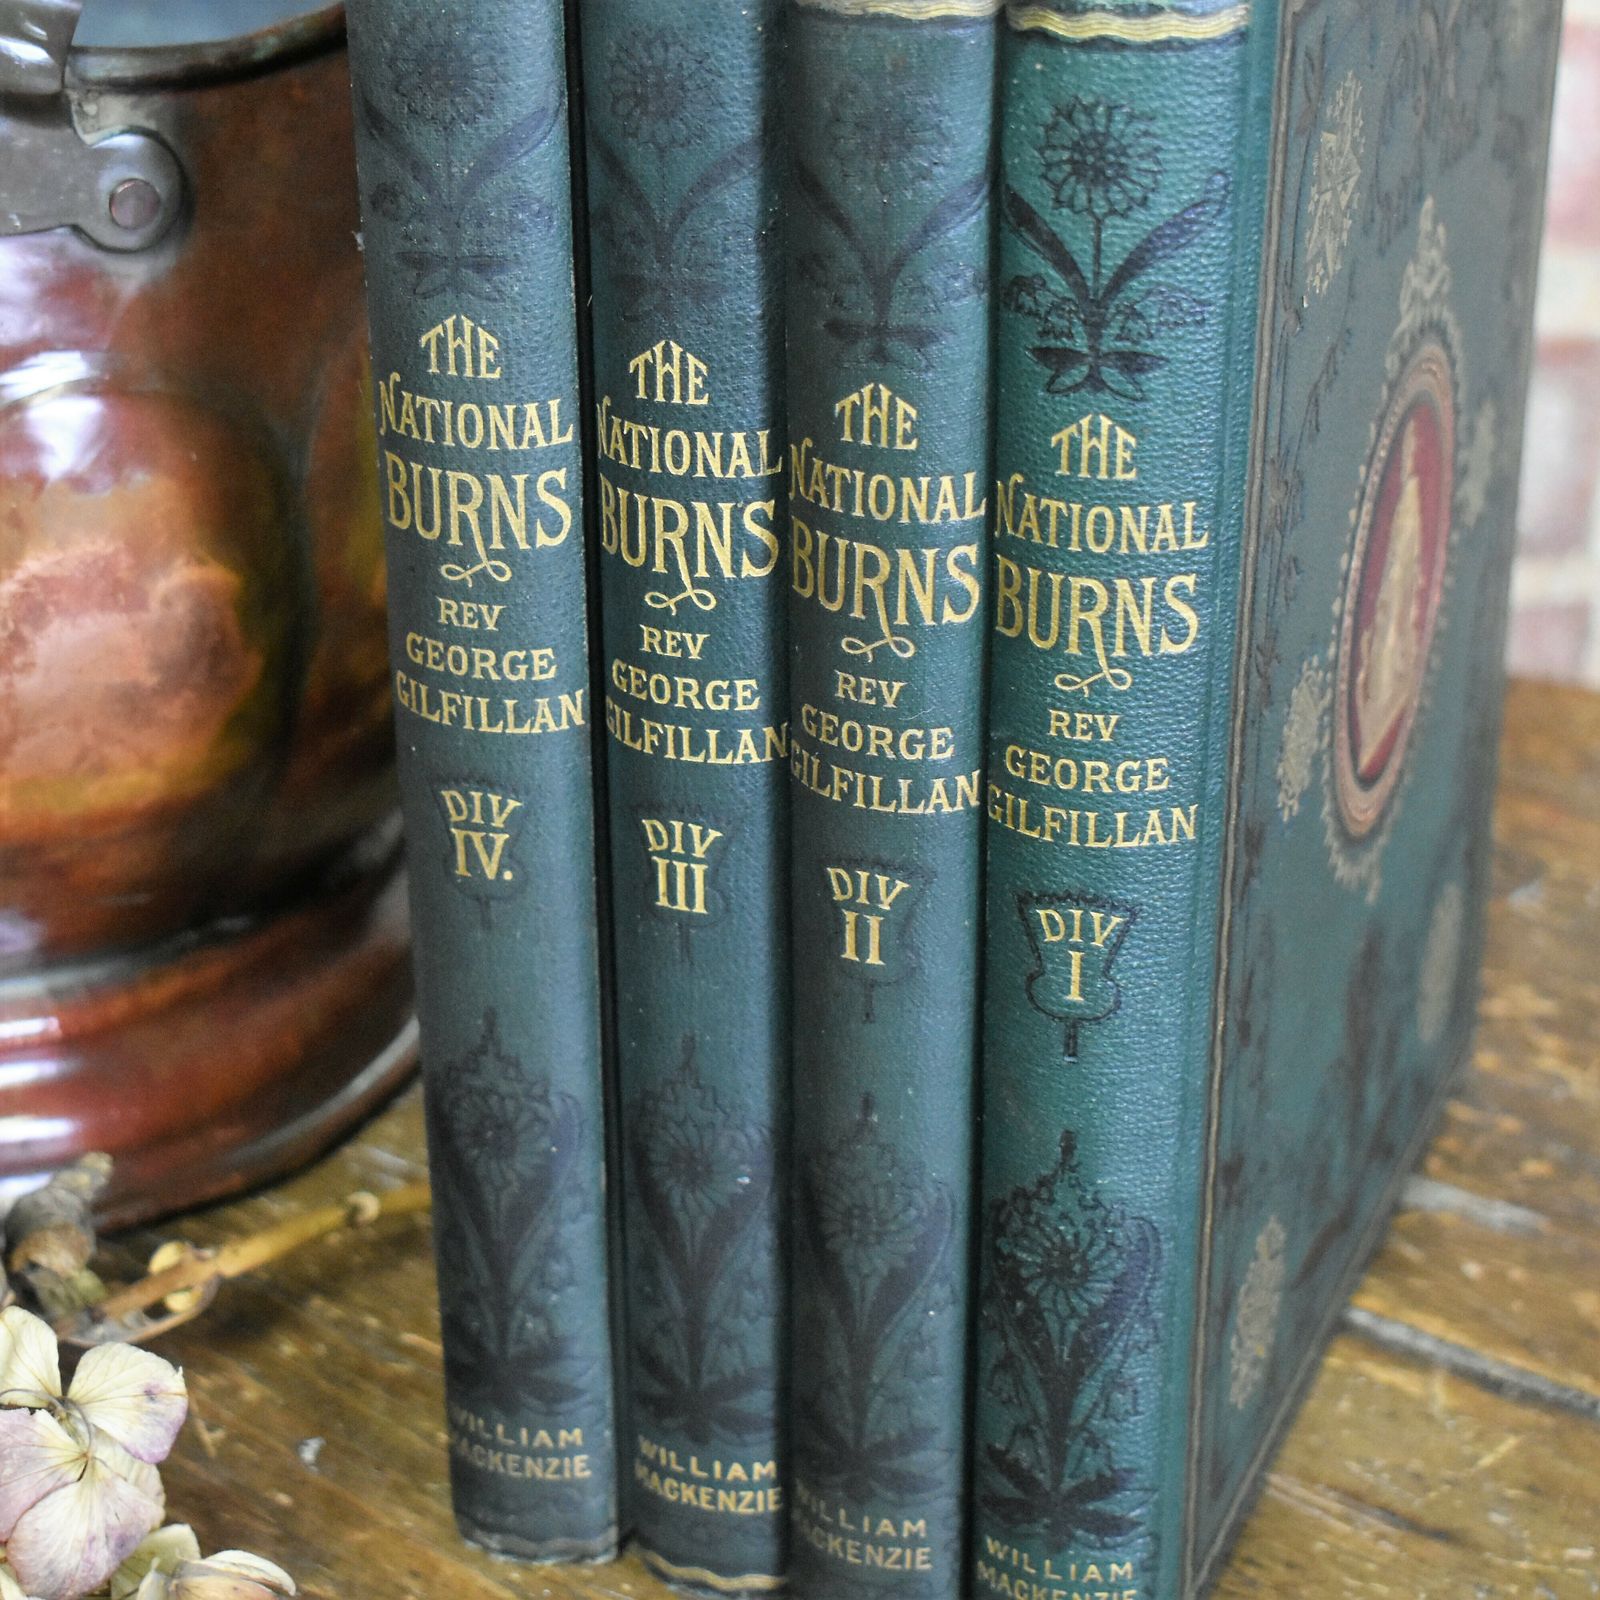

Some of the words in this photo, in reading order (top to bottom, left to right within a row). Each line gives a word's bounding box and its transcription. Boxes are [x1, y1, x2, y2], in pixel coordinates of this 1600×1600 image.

[421, 313, 502, 379] THE
[629, 339, 710, 405] THE
[378, 372, 574, 451] NATIONAL
[596, 395, 783, 479] NATIONAL
[835, 382, 918, 451] THE
[1050, 413, 1137, 481] THE
[788, 437, 987, 524] NATIONAL
[384, 449, 572, 587] BURNS
[994, 472, 1209, 555] NATIONAL
[599, 472, 780, 615] BURNS
[437, 596, 506, 631] REV
[791, 514, 980, 662] BURNS
[640, 624, 710, 660] REV
[995, 553, 1199, 698] BURNS
[405, 631, 558, 681] GEORGE
[611, 658, 761, 711] GEORGE
[396, 670, 586, 734] GILFILLAN
[834, 670, 908, 709] REV
[605, 694, 791, 765] GILFILLAN
[801, 703, 955, 761] GEORGE
[1048, 709, 1120, 742] REV
[790, 739, 981, 815] GILFILLAN
[1004, 744, 1171, 794] GEORGE
[441, 789, 523, 829] DIV
[988, 783, 1199, 848] GILFILLAN
[450, 827, 514, 880] IV.
[641, 818, 724, 859] DIV
[651, 856, 709, 915] III
[826, 866, 909, 911] DIV
[840, 910, 886, 965] II
[1036, 908, 1127, 948] DIV
[1066, 950, 1086, 1002] I
[638, 1435, 777, 1482] WILLIAM
[986, 1535, 1133, 1583] WILLIAM
